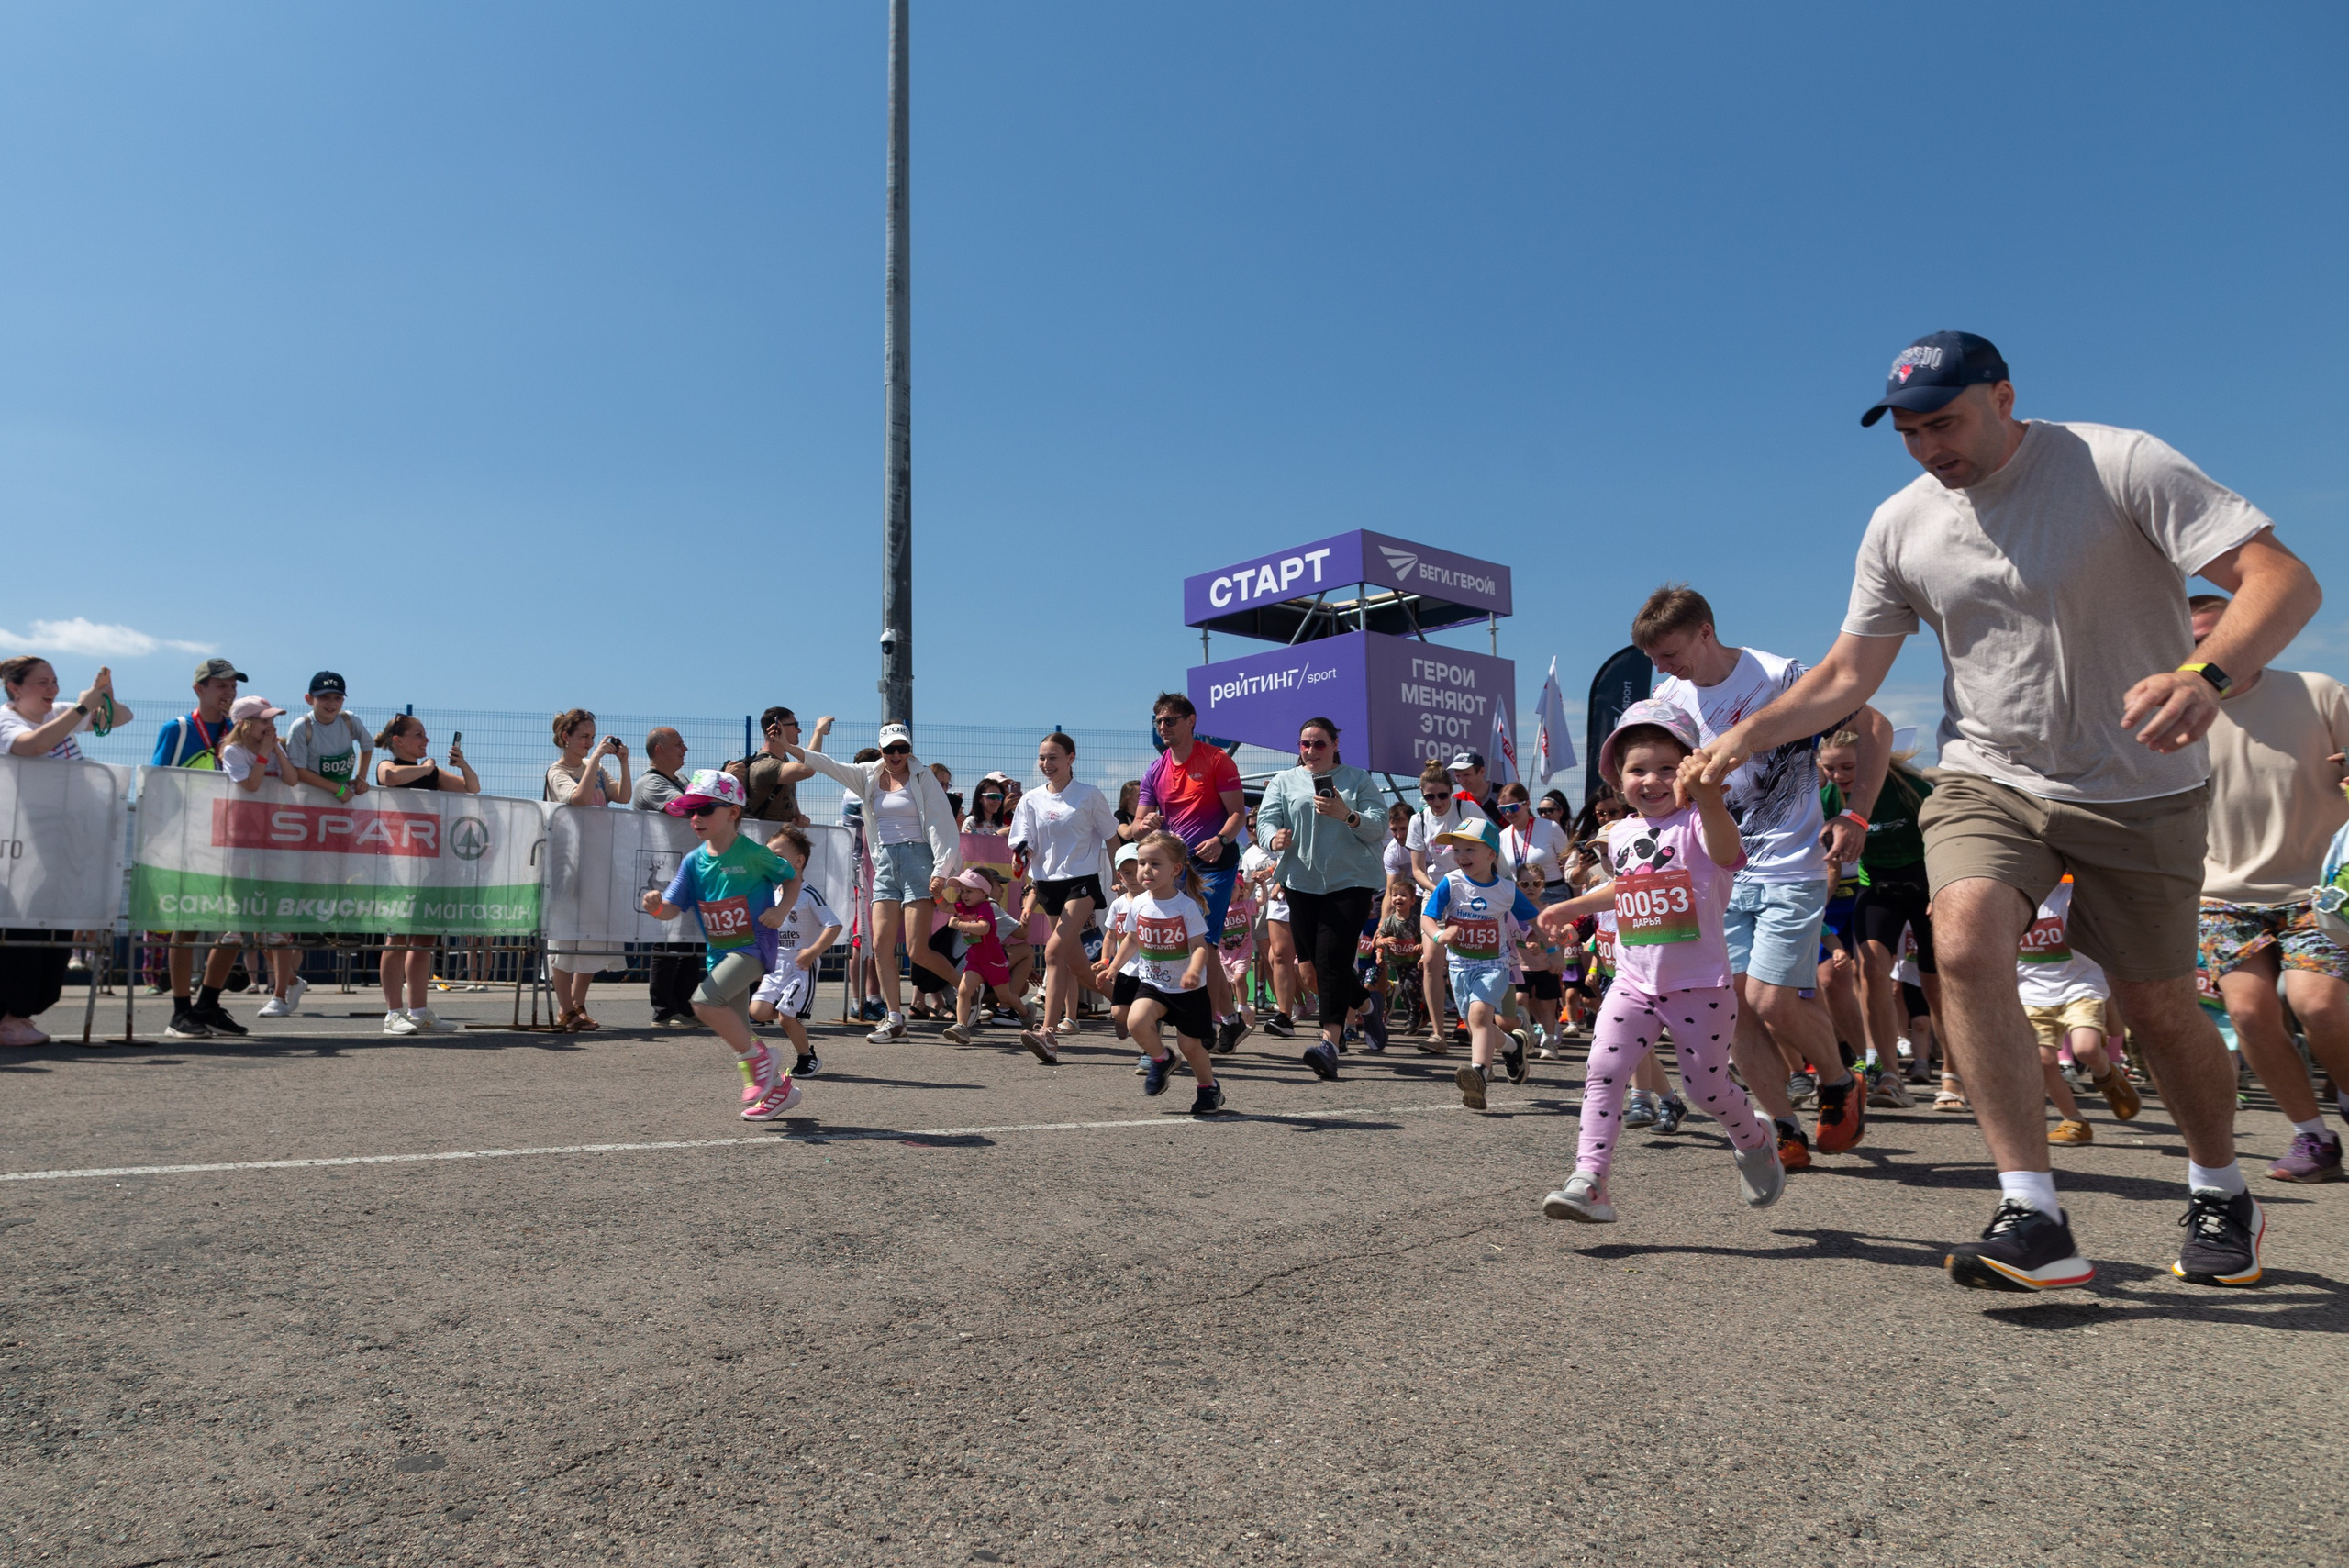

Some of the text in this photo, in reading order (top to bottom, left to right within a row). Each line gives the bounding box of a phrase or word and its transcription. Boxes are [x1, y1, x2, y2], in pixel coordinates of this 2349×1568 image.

[1209, 548, 1330, 608] СТАРТ
[1412, 658, 1475, 689] ГЕРОИ
[1401, 682, 1486, 716] МЕНЯЮТ
[1622, 681, 1632, 709] sport
[1420, 712, 1471, 739] ЭТОТ
[271, 811, 436, 850] SPAR
[159, 891, 531, 922] самый вкусный магазин
[1615, 887, 1689, 918] 30053
[703, 907, 748, 929] 0132
[1224, 914, 1246, 927] 0063
[1633, 917, 1662, 929] ДАРЬЯ
[778, 930, 800, 939] rates
[1138, 925, 1185, 944] 30126
[1456, 929, 1497, 944] 0153
[2019, 927, 2063, 946] 120
[792, 983, 800, 999] 7
